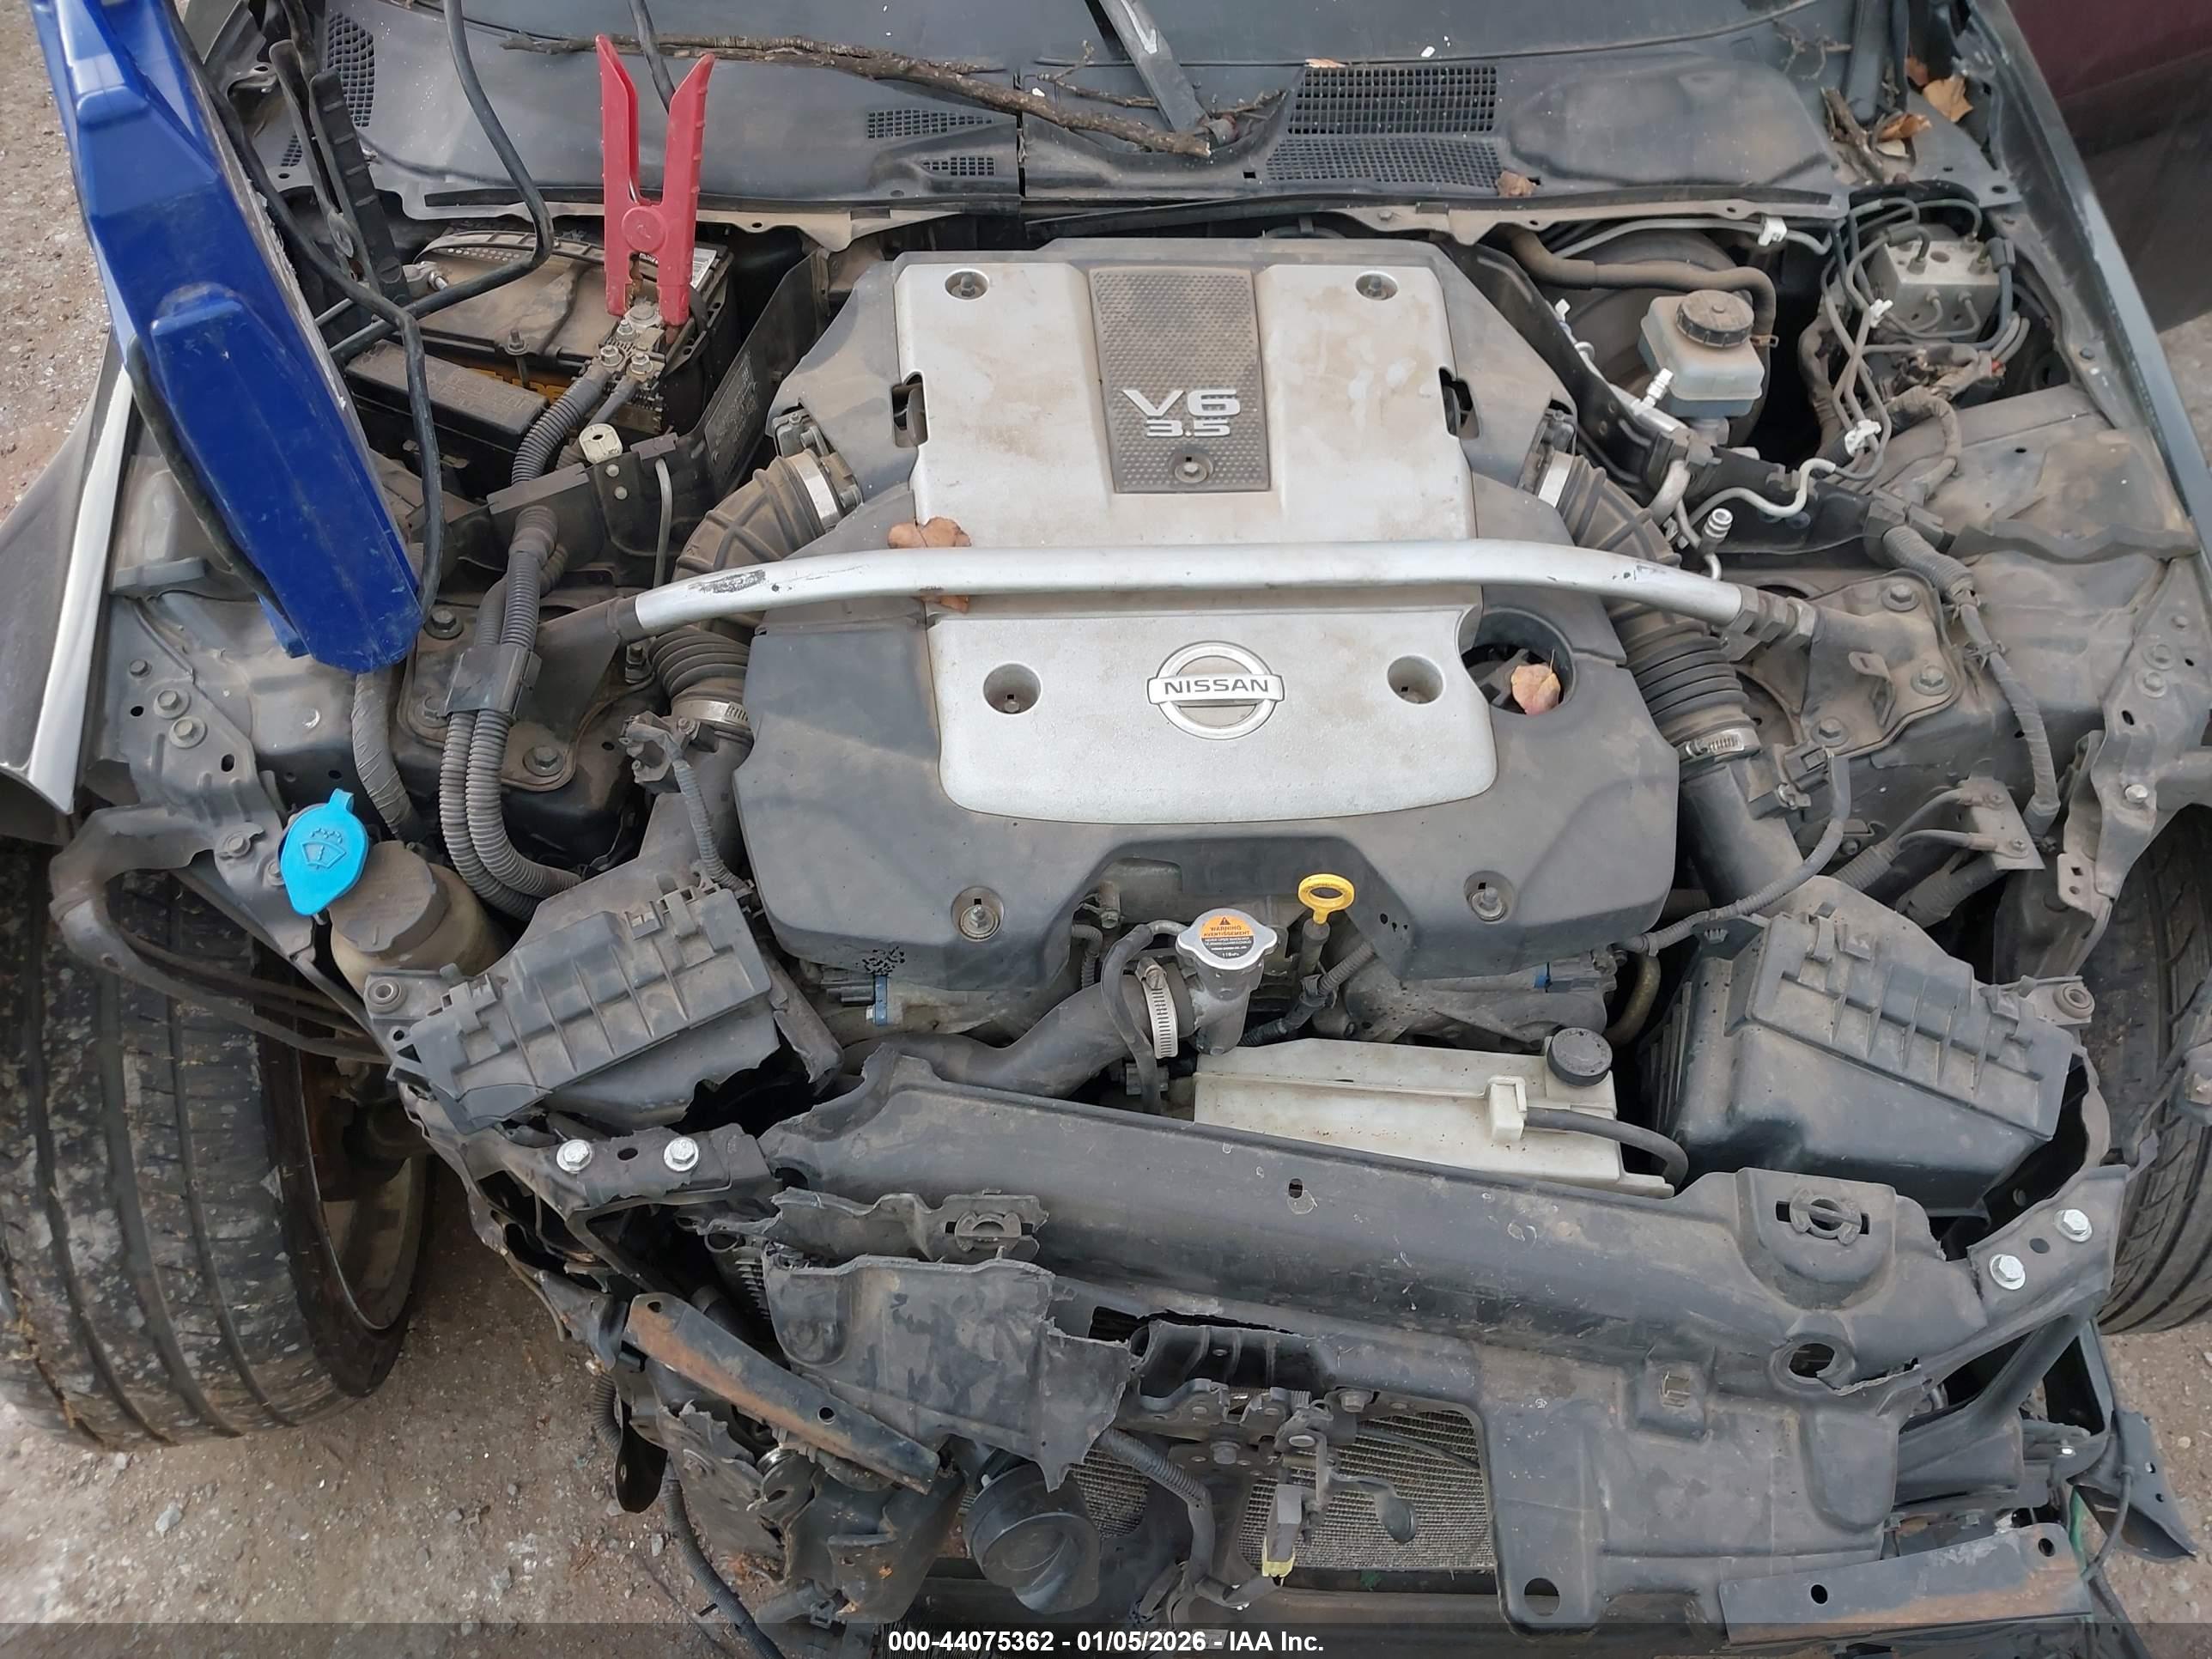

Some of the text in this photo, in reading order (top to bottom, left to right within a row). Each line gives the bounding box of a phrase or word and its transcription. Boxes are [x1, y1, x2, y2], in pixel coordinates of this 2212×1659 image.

[1122, 389, 1241, 417] V6
[1146, 419, 1231, 438] 3.5
[1164, 678, 1269, 695] NISSAN
